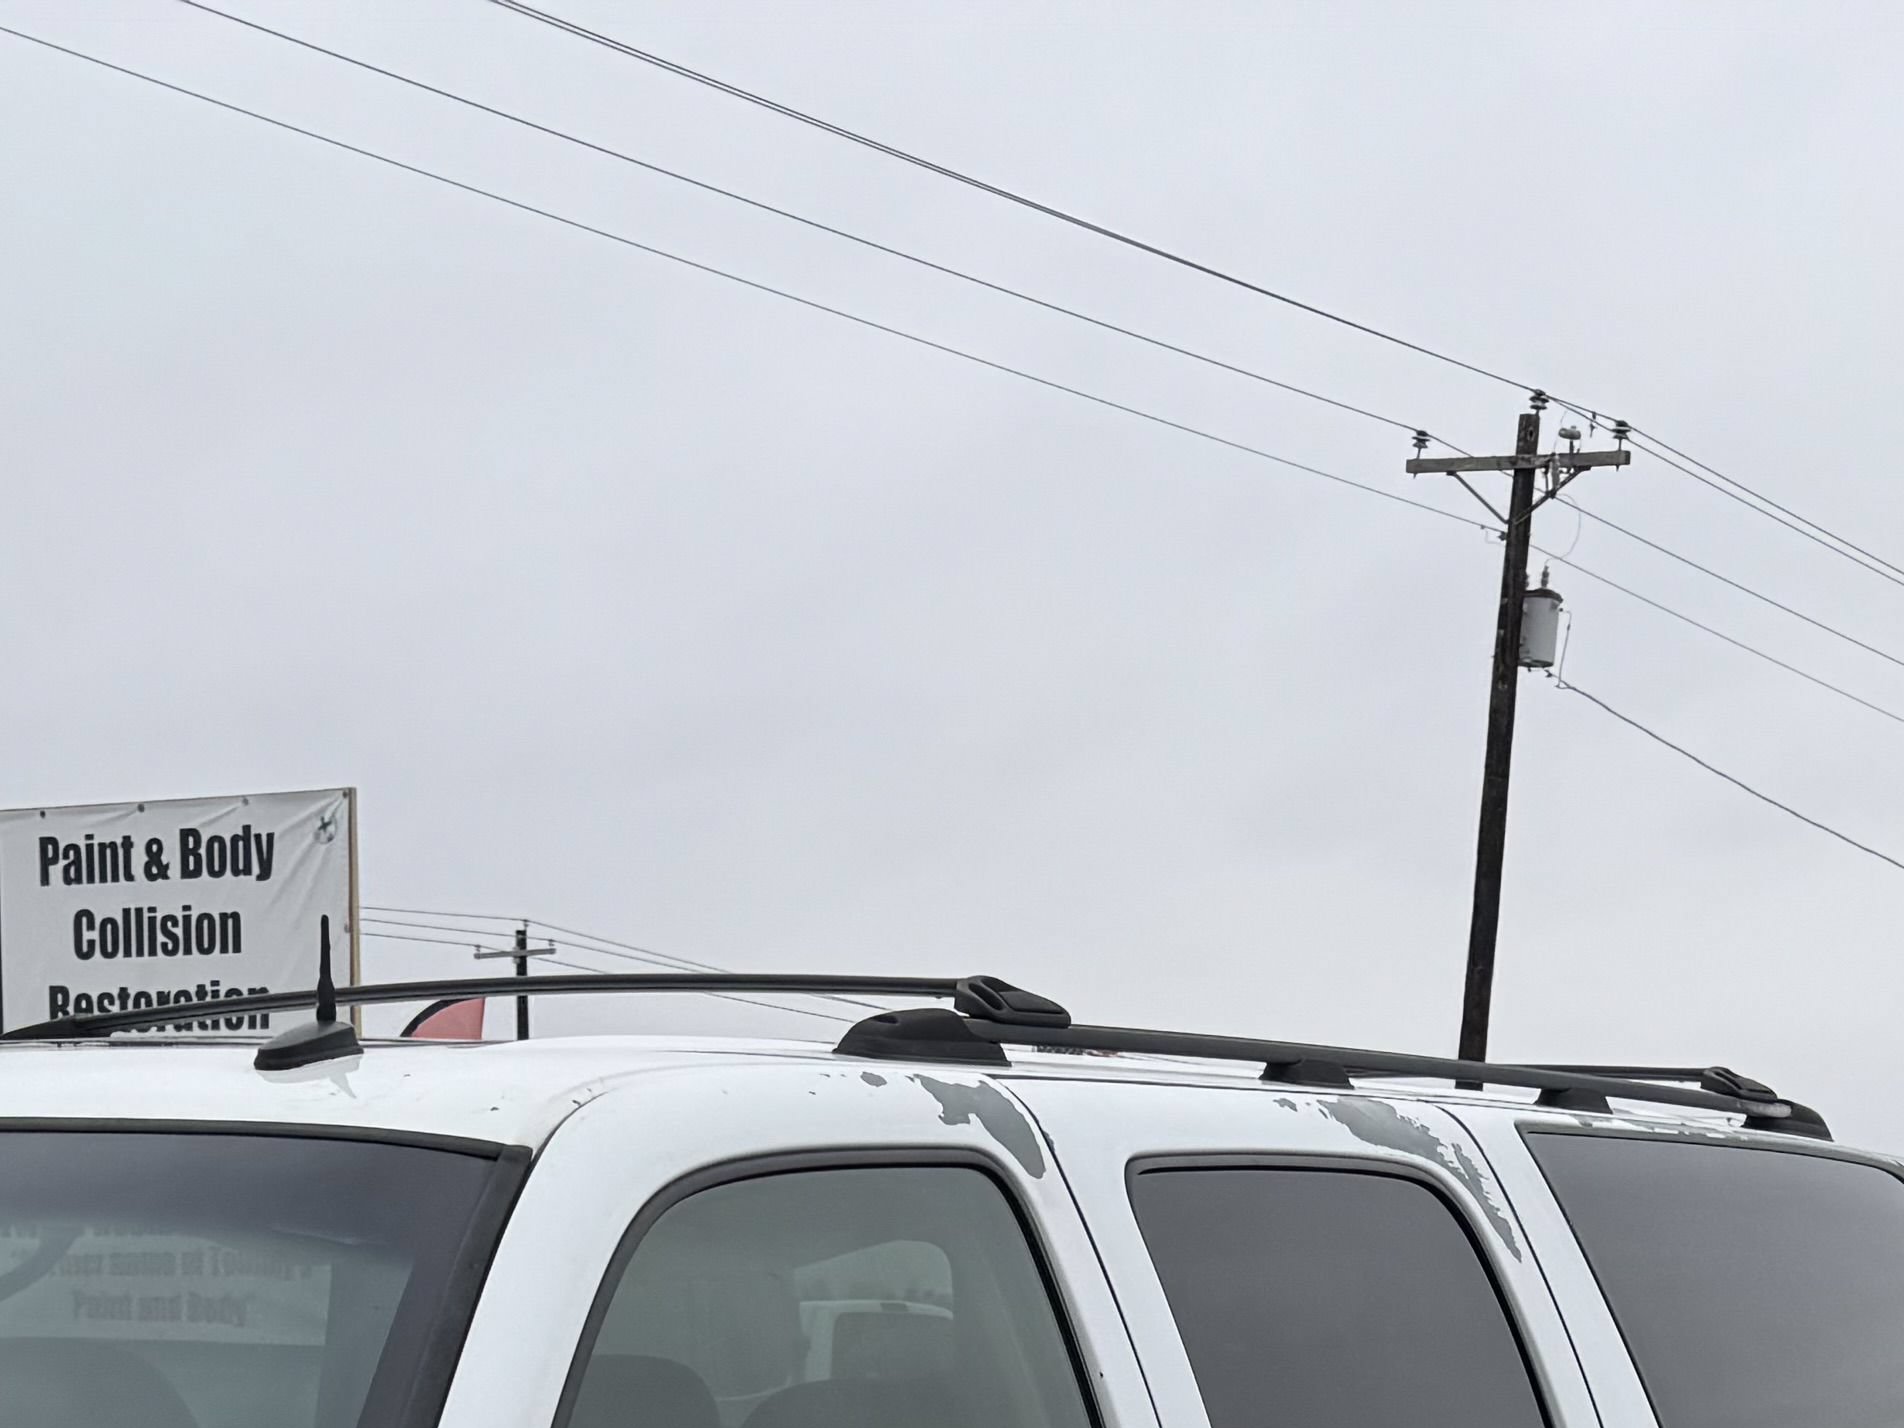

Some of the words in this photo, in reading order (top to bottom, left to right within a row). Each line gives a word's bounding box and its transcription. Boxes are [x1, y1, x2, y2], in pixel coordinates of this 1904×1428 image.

[39, 833, 138, 886] Paint
[143, 838, 171, 881] &
[181, 824, 275, 882] Body
[73, 907, 242, 959] Collision
